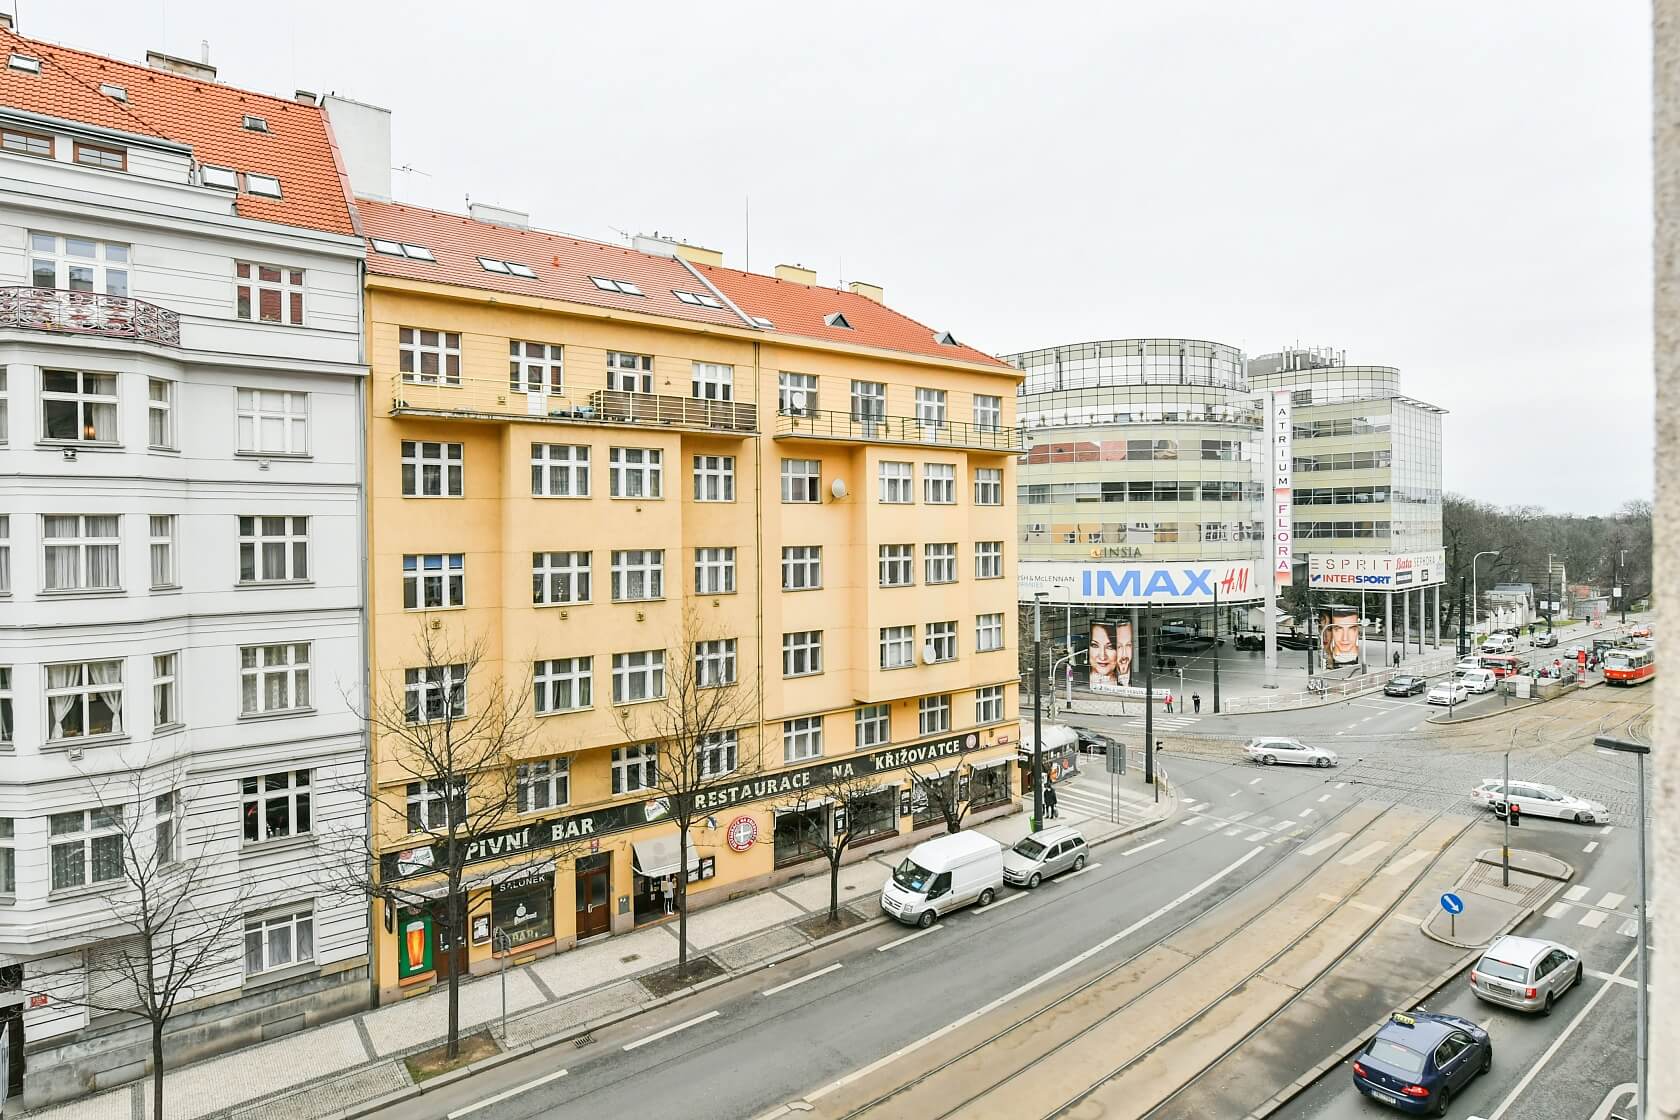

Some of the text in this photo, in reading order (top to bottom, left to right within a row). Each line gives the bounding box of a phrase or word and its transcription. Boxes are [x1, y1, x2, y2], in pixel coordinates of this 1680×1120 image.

[1278, 408, 1288, 485] ATRIUM
[1278, 505, 1289, 570] FLORA
[1104, 546, 1142, 558] INSIA
[1311, 558, 1391, 570] ESPRIT
[1082, 569, 1213, 597] IMAX
[1220, 567, 1249, 594] H&M
[1323, 574, 1392, 584] INTERSPORT
[695, 771, 811, 809] RESTAURACE
[832, 763, 854, 779] NA
[875, 739, 960, 770] KŘIŽOVATCE
[465, 818, 594, 860] PIVNÍ BAR
